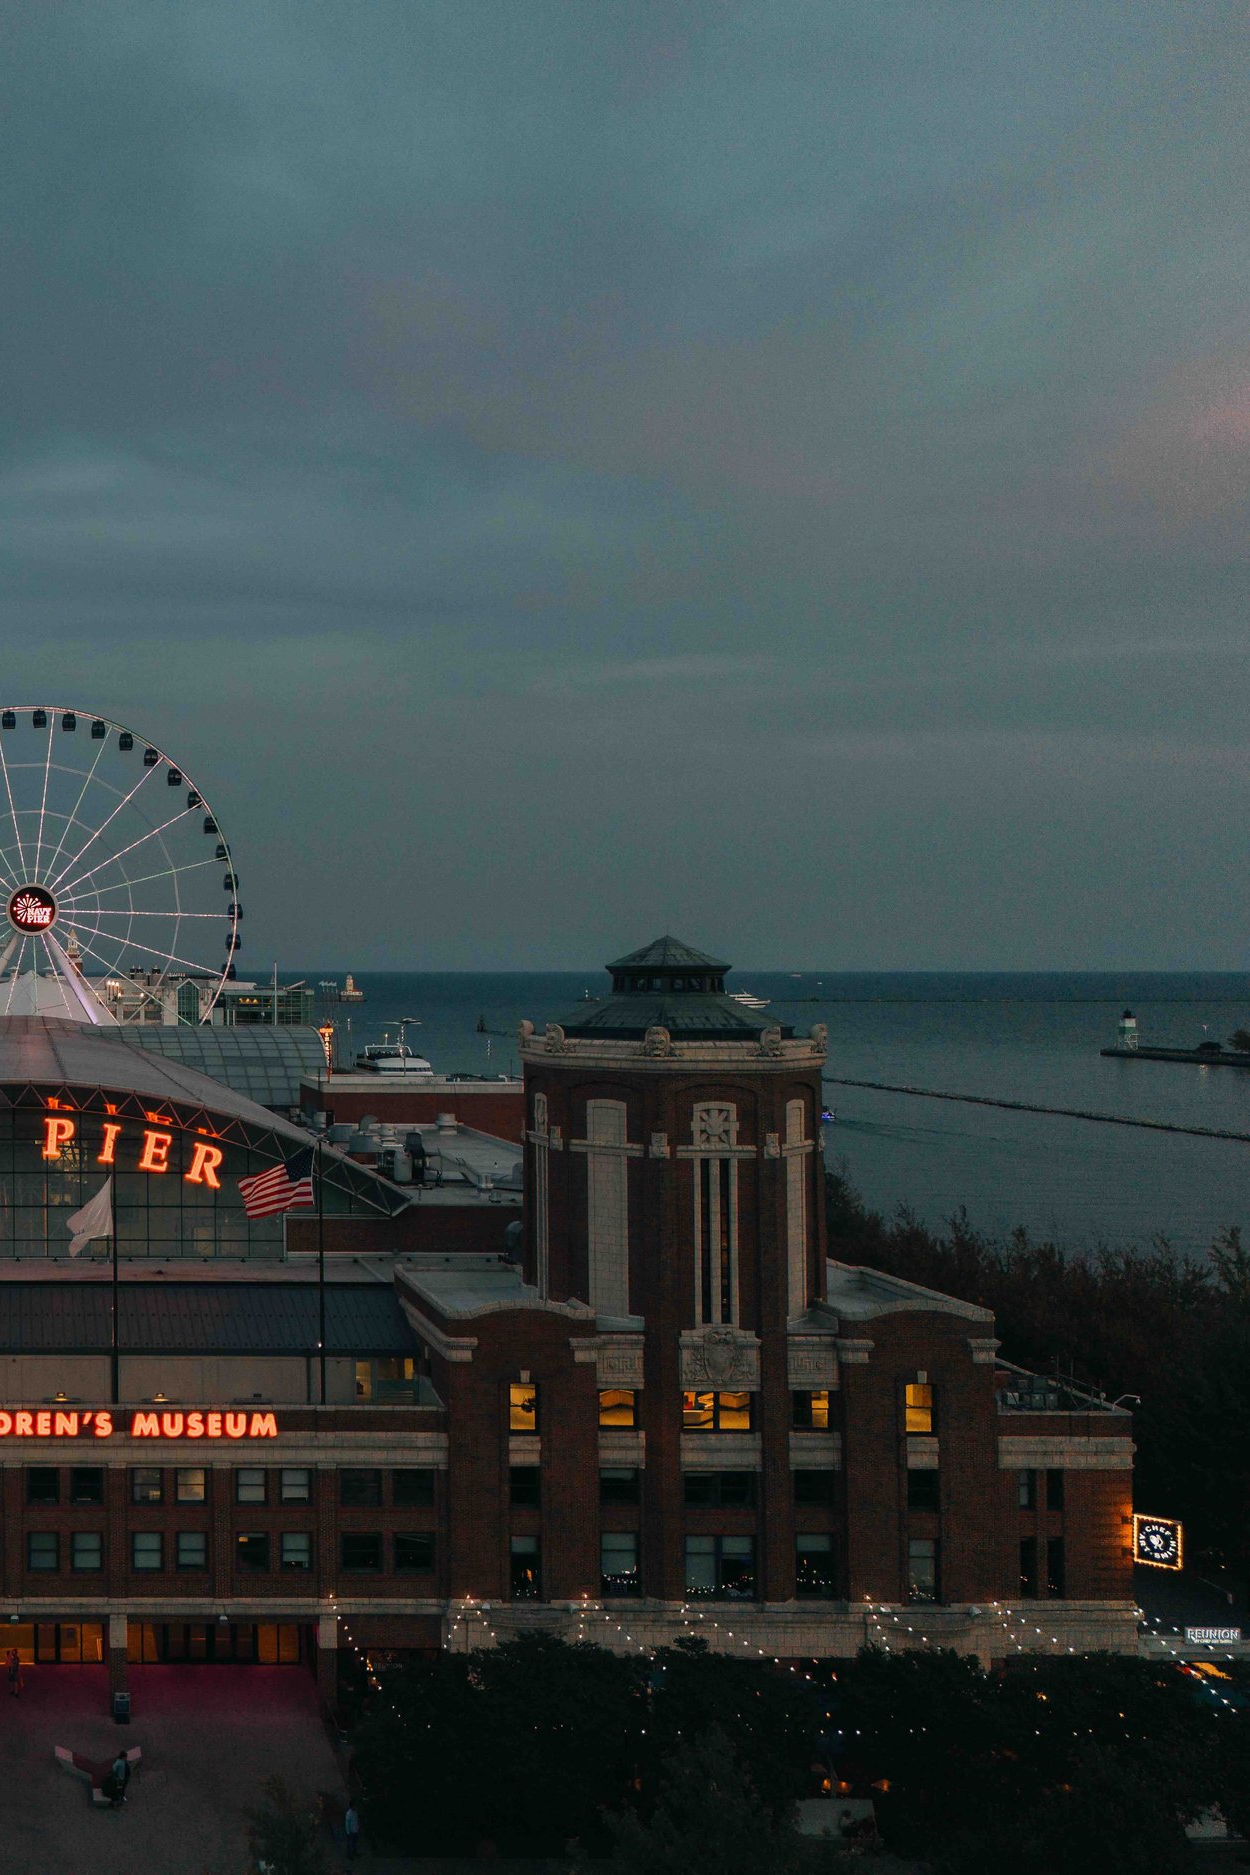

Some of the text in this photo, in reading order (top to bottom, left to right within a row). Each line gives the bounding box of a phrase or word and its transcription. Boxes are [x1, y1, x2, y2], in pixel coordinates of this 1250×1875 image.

[27, 907, 52, 916] NAVY
[27, 915, 50, 923] PIER
[42, 1116, 224, 1189] PIER
[132, 1411, 278, 1438] MUSEUM
[1145, 1525, 1172, 1536] CHEF
[1138, 1533, 1151, 1552] ART
[1154, 1540, 1177, 1559] SMITH
[1187, 1629, 1239, 1640] REUNION
